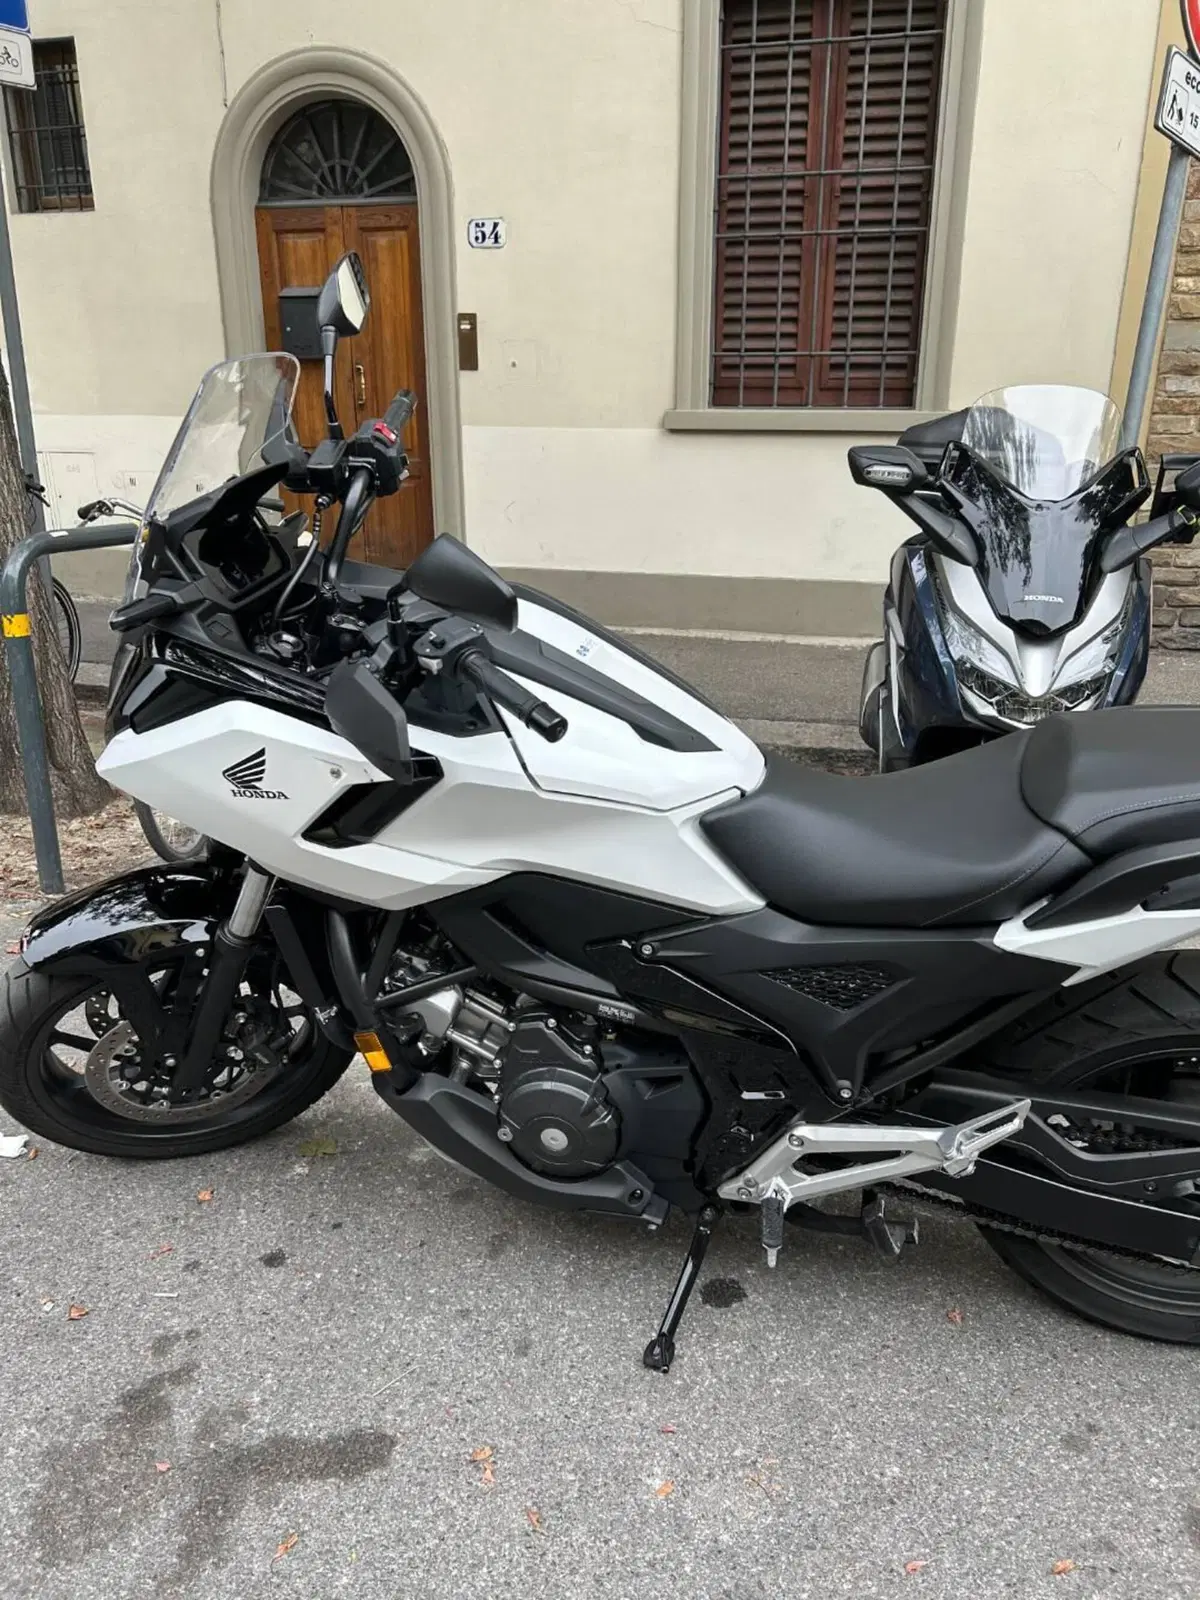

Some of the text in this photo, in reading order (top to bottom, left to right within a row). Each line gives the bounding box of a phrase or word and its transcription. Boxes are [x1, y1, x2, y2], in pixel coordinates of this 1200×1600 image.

[1190, 112, 1199, 129] 15
[474, 221, 502, 244] 54
[1023, 594, 1064, 603] HONDA
[230, 789, 291, 800] HONDA
